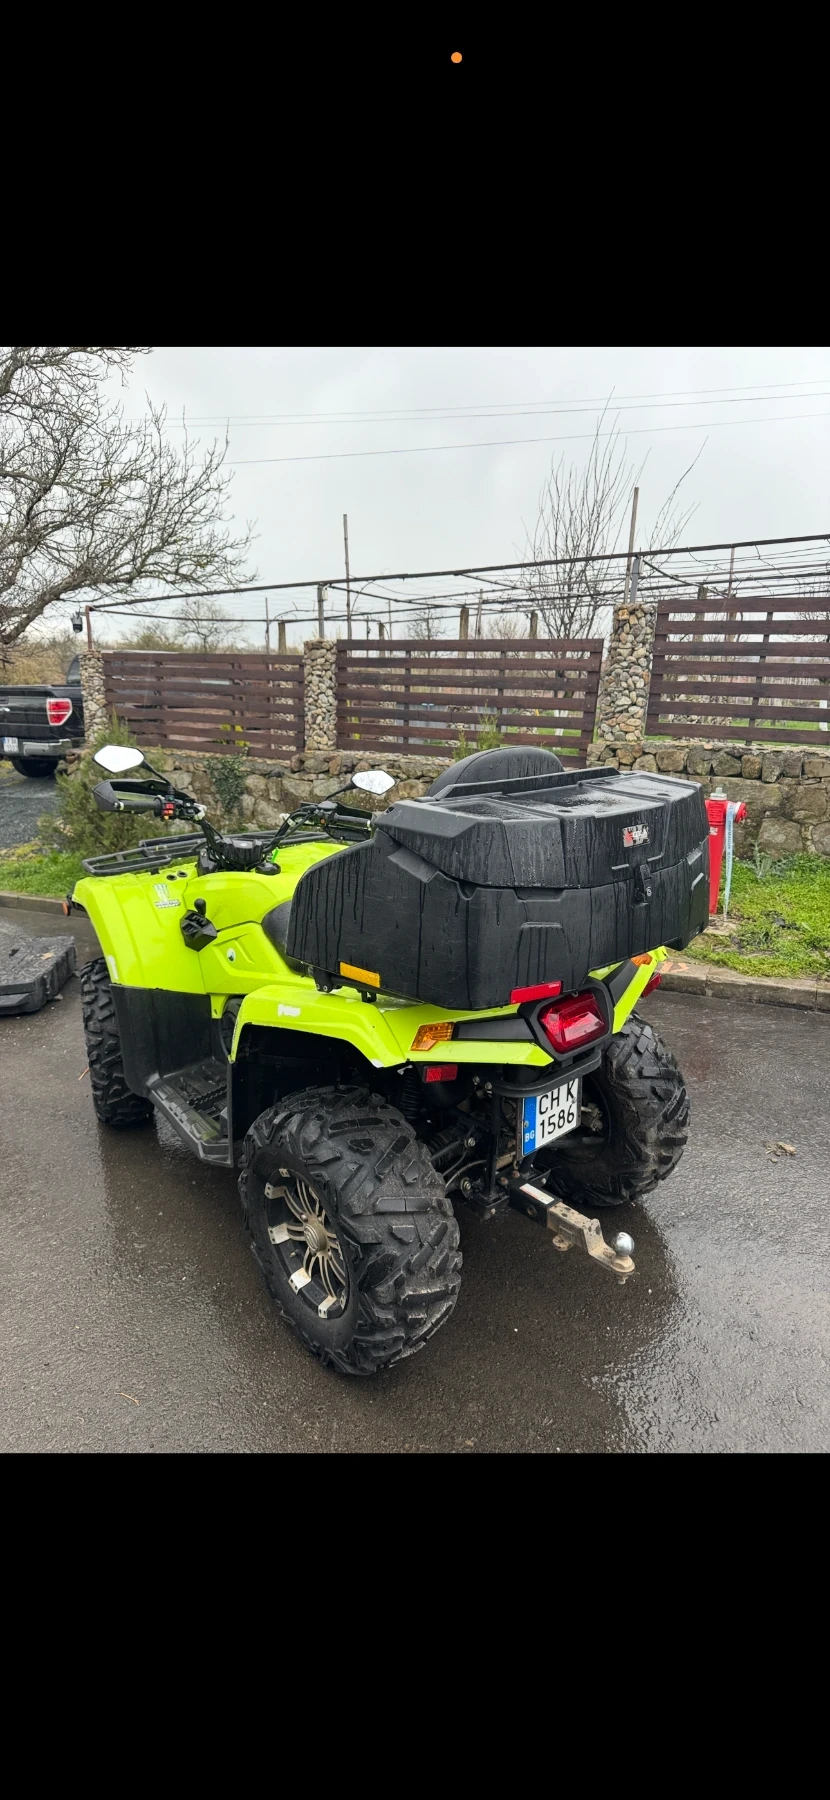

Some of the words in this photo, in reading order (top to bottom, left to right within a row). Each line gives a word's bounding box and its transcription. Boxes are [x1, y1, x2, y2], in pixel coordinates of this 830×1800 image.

[539, 1088, 560, 1115] CH
[566, 1080, 576, 1102] K
[524, 1130, 535, 1142] BG
[539, 1104, 575, 1139] 1586
